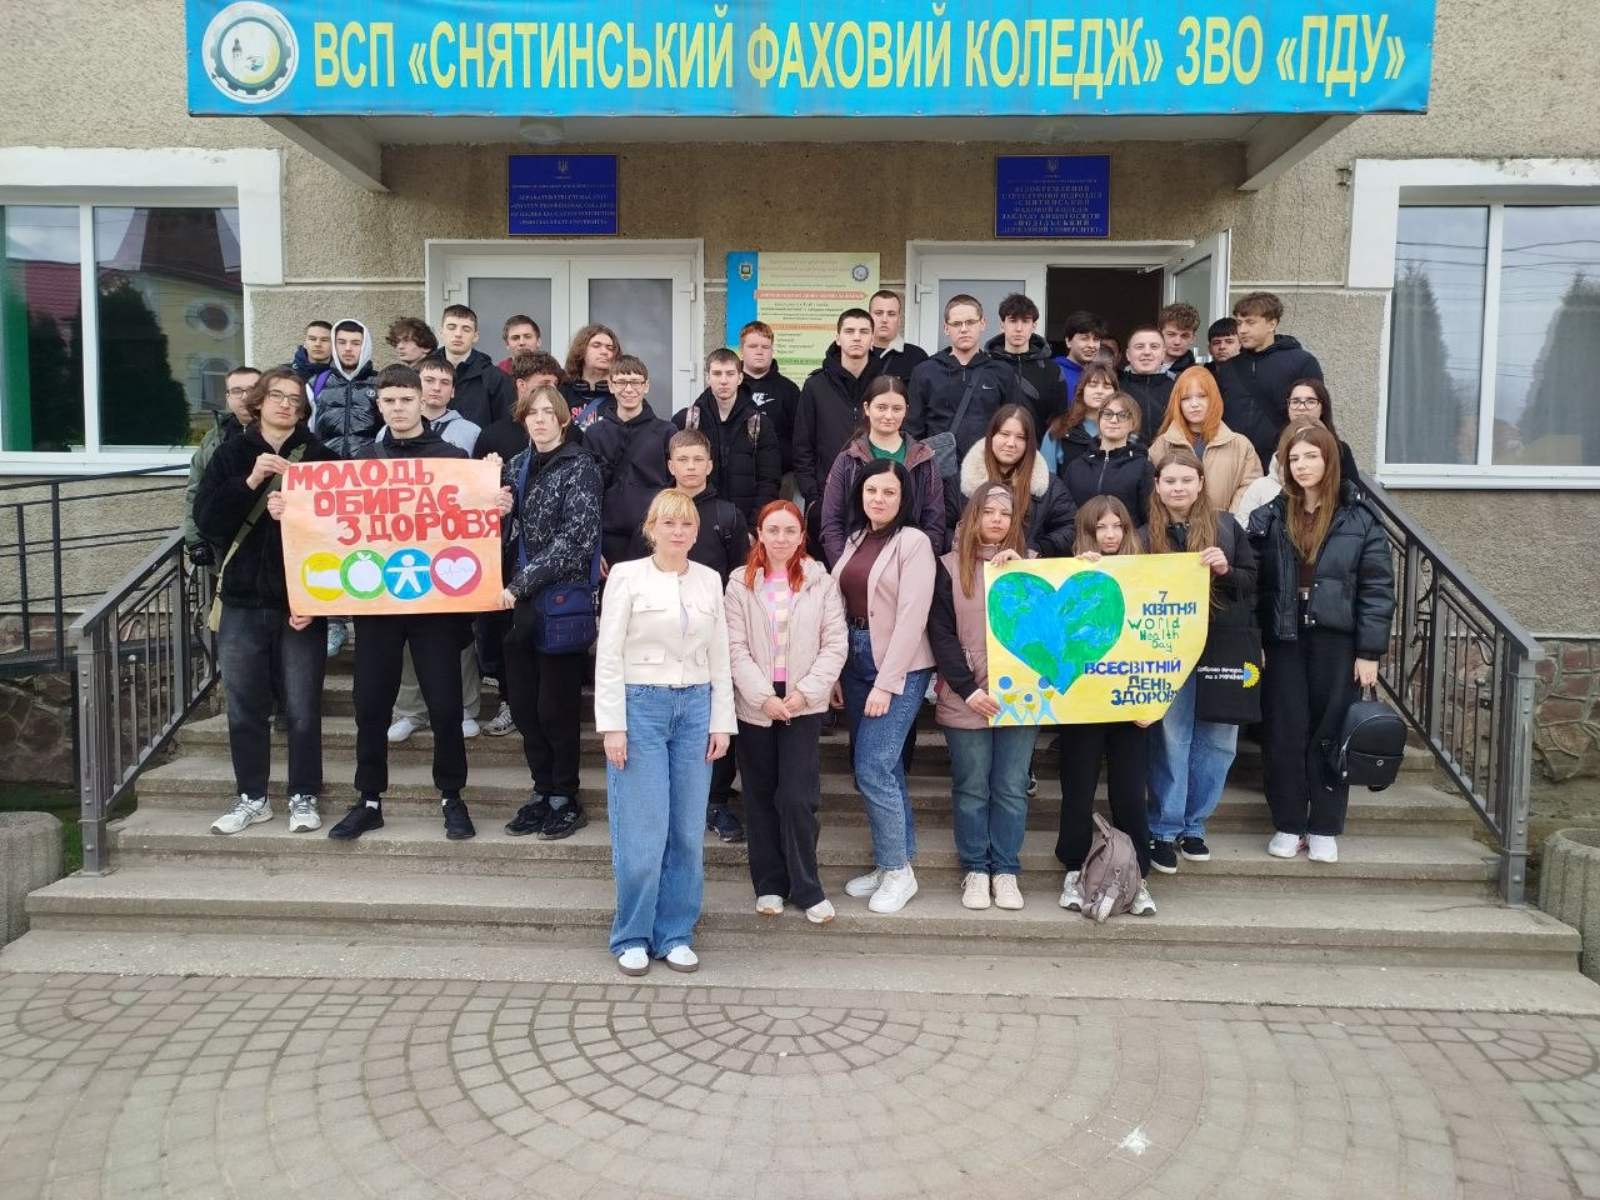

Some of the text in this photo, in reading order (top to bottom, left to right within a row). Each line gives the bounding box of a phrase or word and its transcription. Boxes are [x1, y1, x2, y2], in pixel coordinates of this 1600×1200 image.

[314, 2, 1406, 100] ВСП «СНЯТИНСЬКИЙ ФАХОВИЙ КОЛЕДЖ» ЗВО «ПДУ»
[287, 459, 434, 490] МОЛОДЬ
[313, 484, 459, 517] ОБИРАЄ
[1159, 590, 1168, 602] 7
[1142, 602, 1197, 616] КВІТНЯ
[1084, 657, 1182, 675] ВСЕСВІТНІЙ
[1127, 675, 1172, 692] ДЕНЬ
